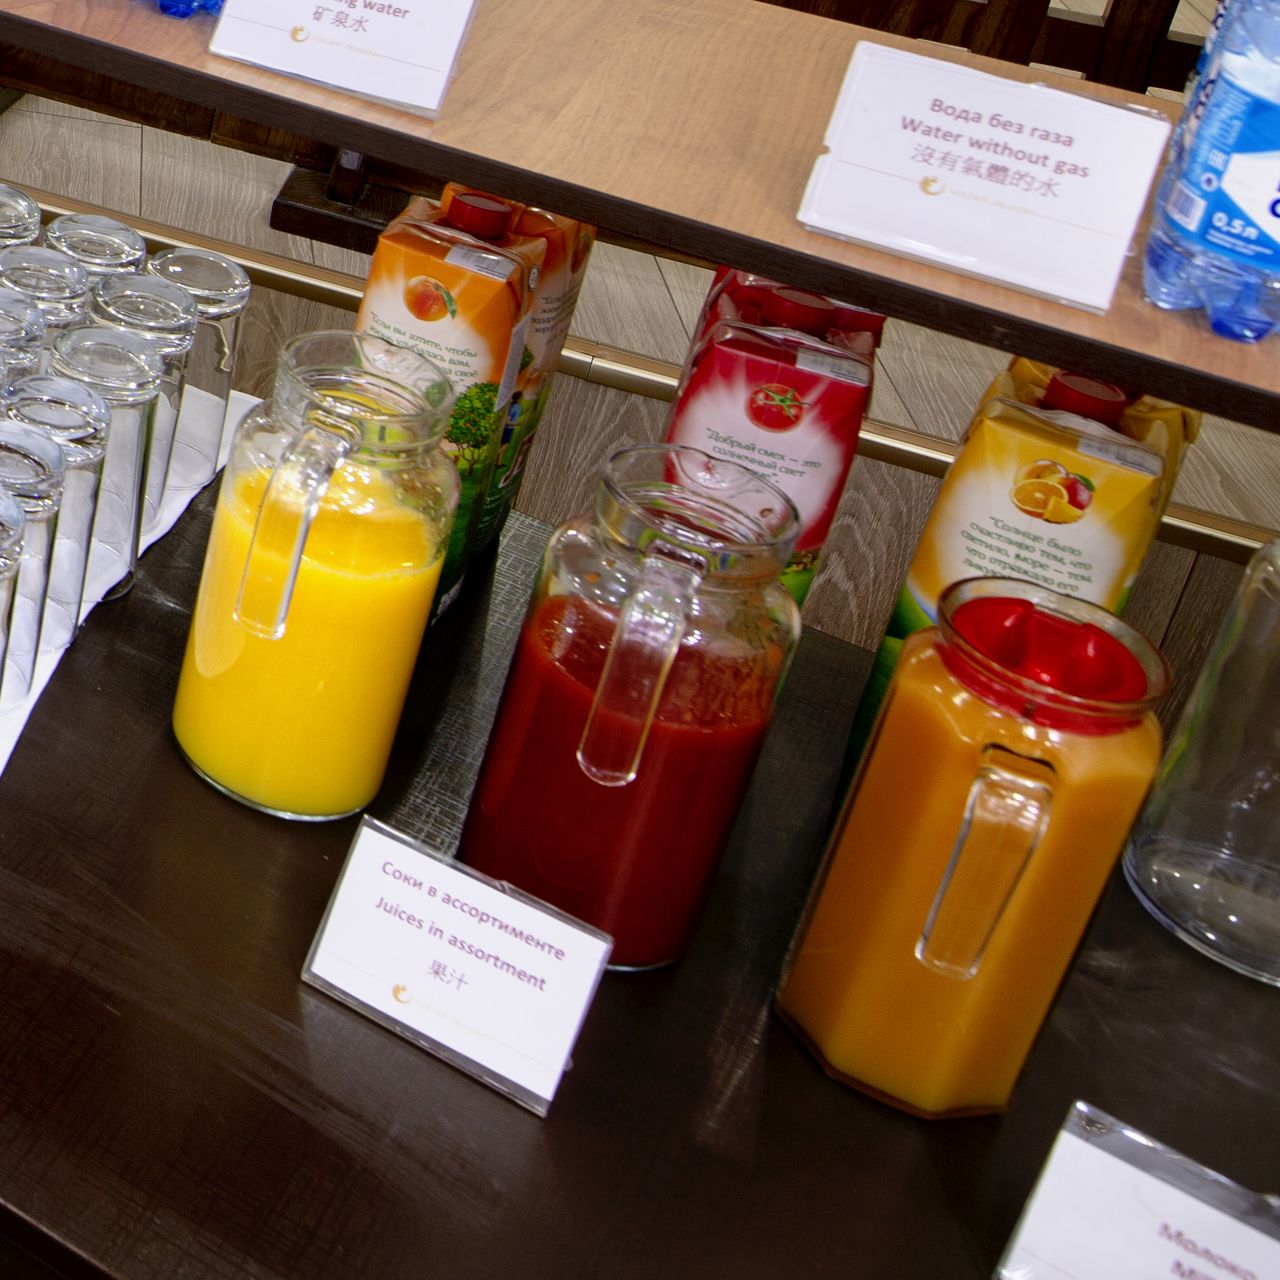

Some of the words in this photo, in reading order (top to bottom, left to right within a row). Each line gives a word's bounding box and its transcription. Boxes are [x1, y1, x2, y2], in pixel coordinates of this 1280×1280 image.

[312, 5, 370, 33] 矿泉水
[363, 0, 411, 19] water
[900, 116, 964, 144] Water
[968, 137, 1050, 168] without
[1053, 160, 1091, 179] gas
[930, 97, 984, 124] Вода
[988, 112, 1025, 135] без
[1029, 126, 1075, 148] газа
[382, 861, 424, 892] Соки
[427, 886, 438, 898] в
[441, 892, 566, 961] ассортименте
[375, 896, 425, 930] Juices
[428, 921, 444, 940] in
[447, 934, 547, 993] assortment
